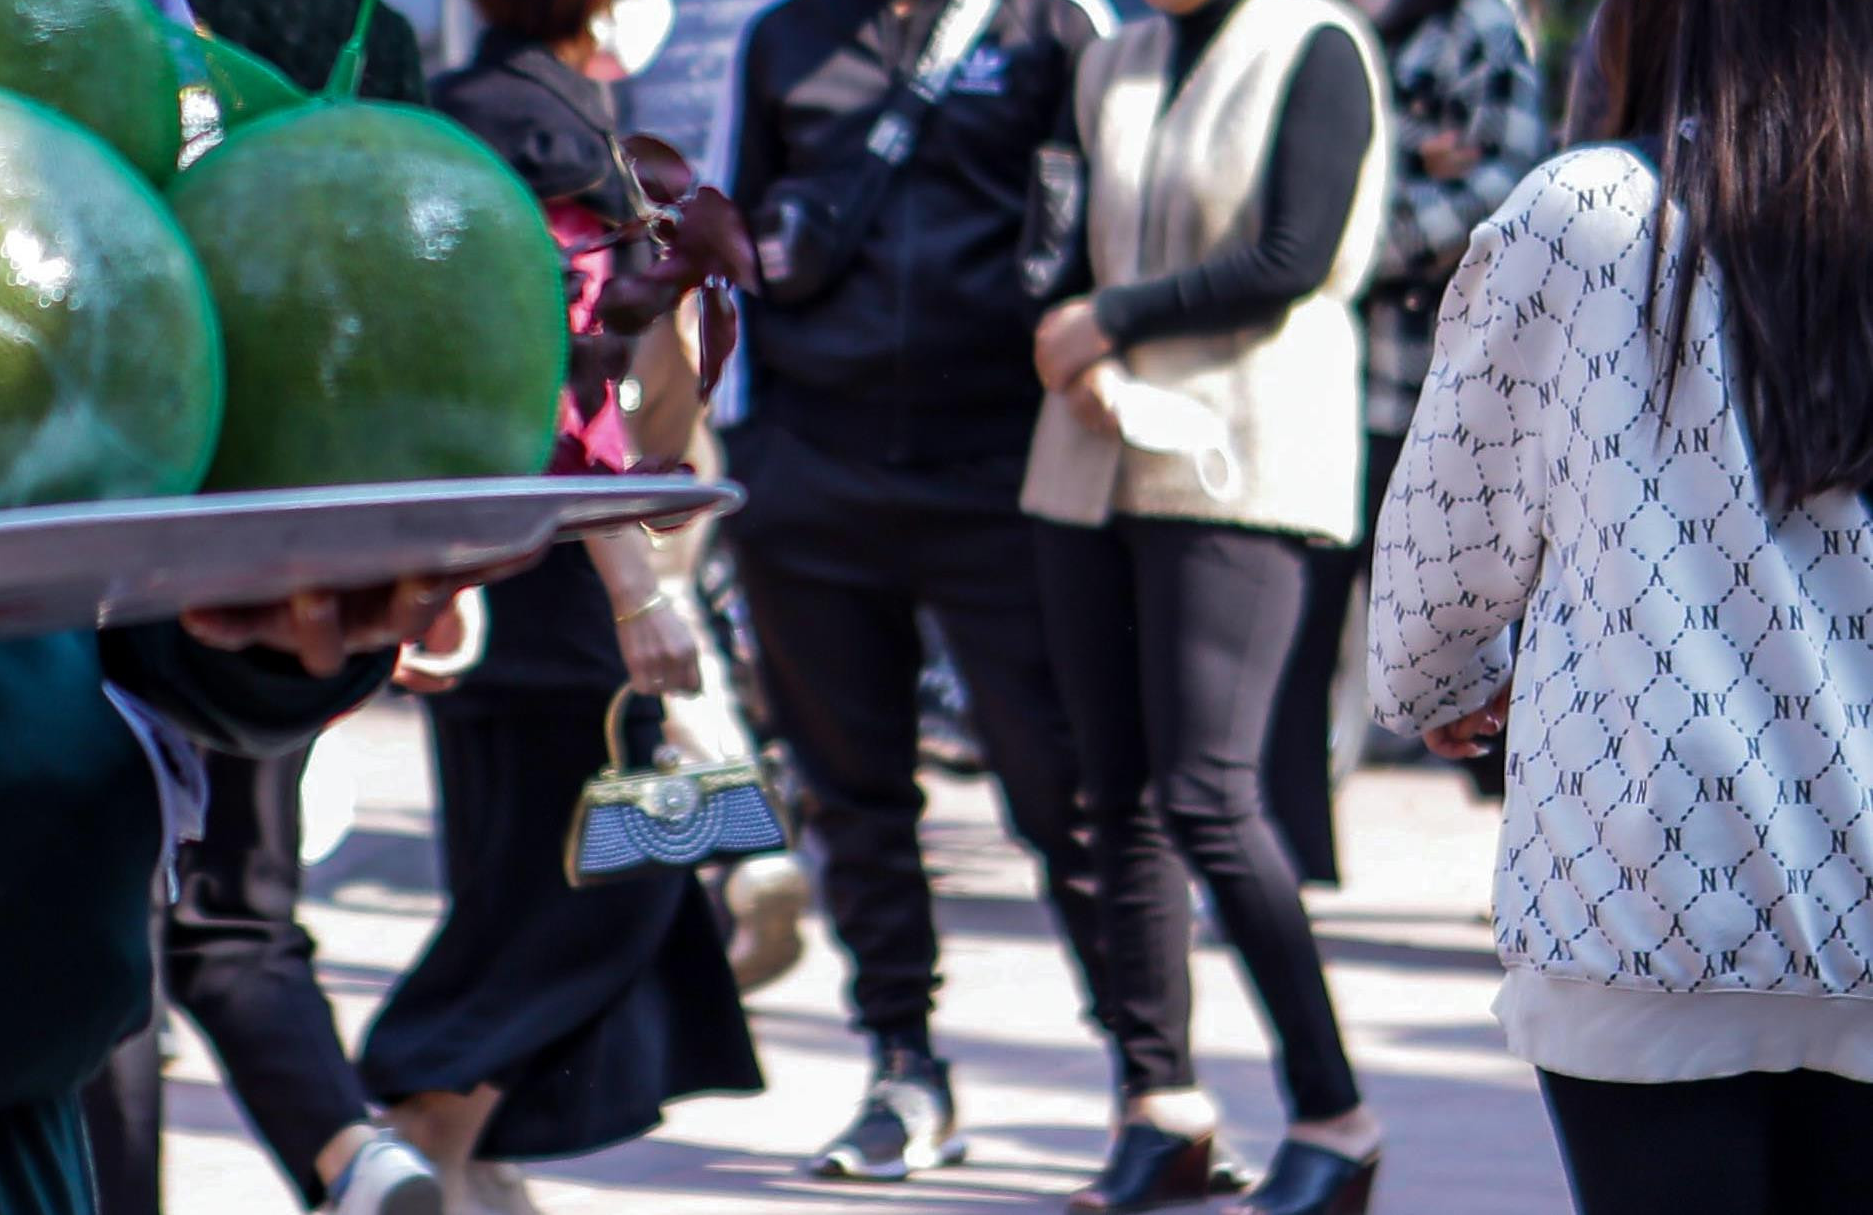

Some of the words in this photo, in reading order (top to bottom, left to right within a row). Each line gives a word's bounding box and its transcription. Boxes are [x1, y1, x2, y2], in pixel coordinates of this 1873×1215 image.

[1678, 518, 1716, 545] NY
[1823, 529, 1861, 555] NY
[1692, 692, 1726, 717] NY
[1773, 695, 1810, 720] NY
[1700, 866, 1737, 893] NY
